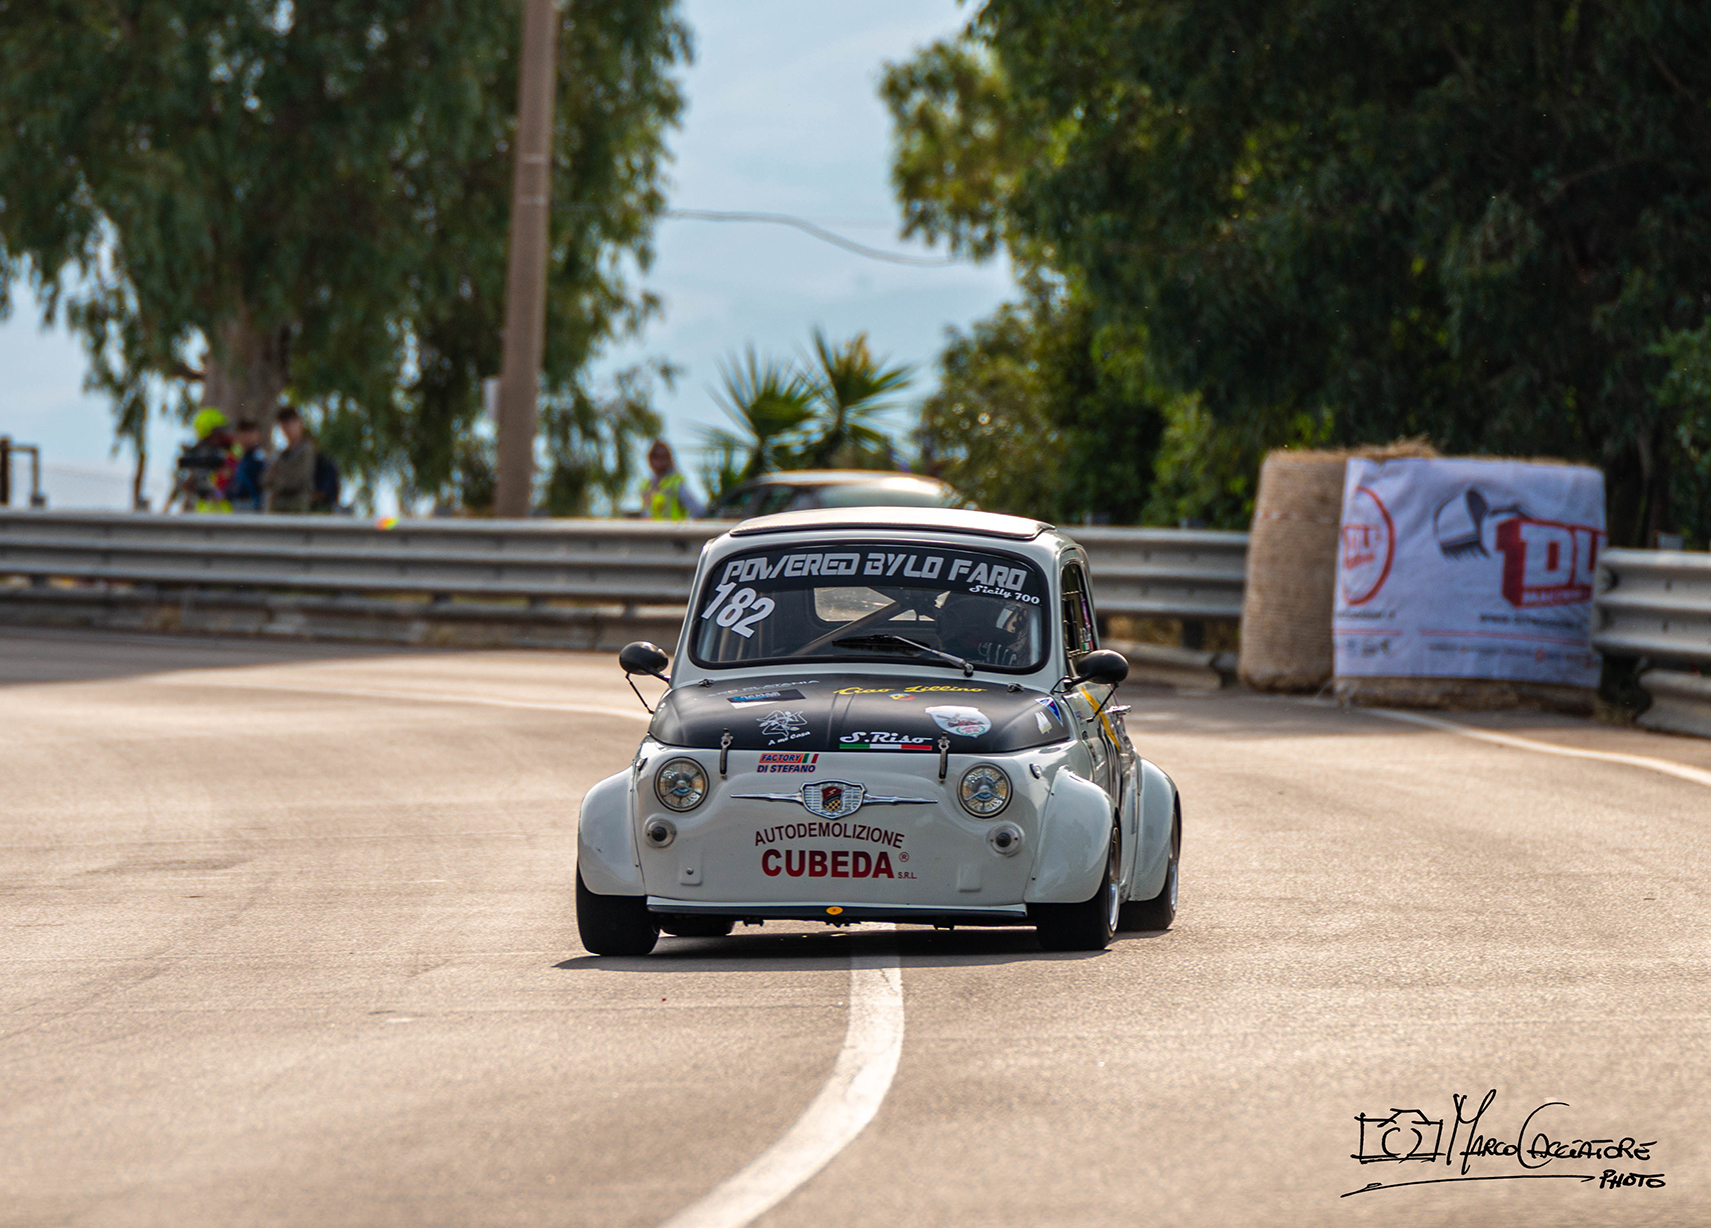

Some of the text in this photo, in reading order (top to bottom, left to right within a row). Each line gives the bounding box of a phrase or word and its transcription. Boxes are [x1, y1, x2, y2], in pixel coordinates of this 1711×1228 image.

[721, 552, 860, 585] POWERED
[947, 558, 1027, 592] FARO
[969, 584, 1040, 605] Sicily 700
[701, 581, 775, 639] 182
[833, 686, 895, 695] Ciao
[756, 764, 816, 773] DI STEFANO
[761, 753, 801, 762] FACTORY
[755, 822, 905, 849] AUTODEMOLIZIONE
[761, 849, 894, 878] CUBEDA
